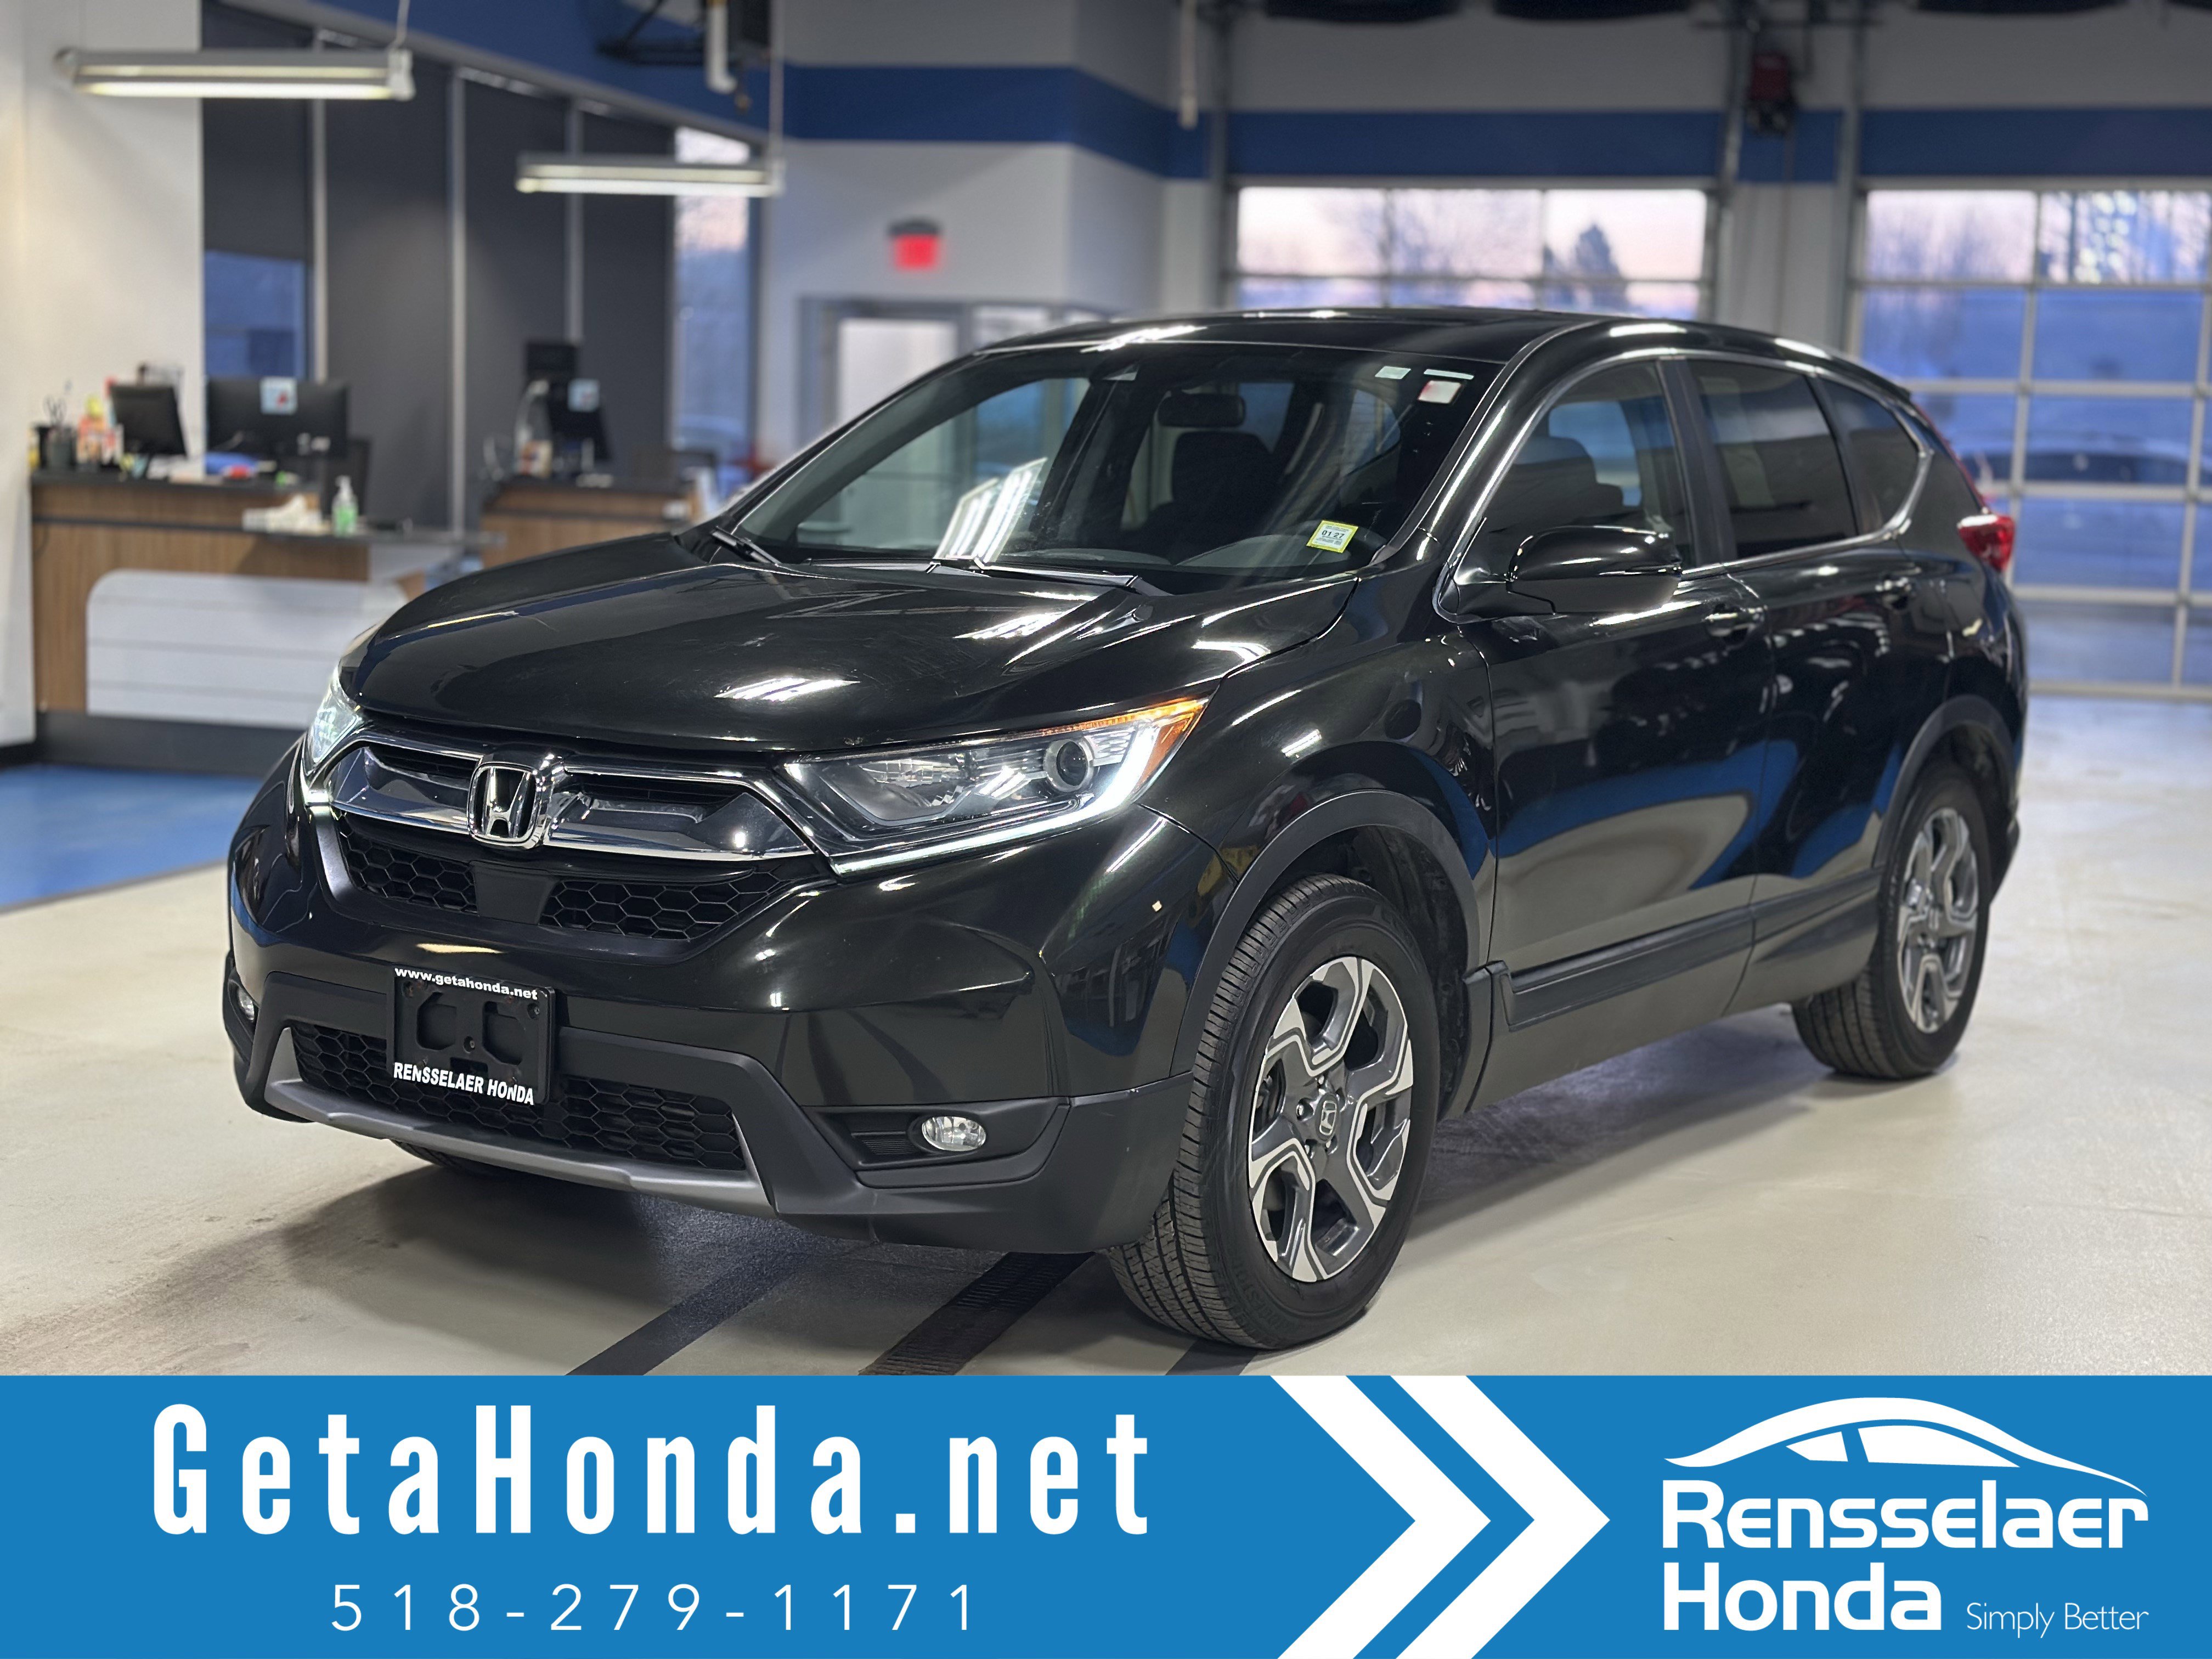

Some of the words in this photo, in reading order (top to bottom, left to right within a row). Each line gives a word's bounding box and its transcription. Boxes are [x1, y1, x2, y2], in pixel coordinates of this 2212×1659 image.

[394, 967, 538, 1000] www.getahonda.net
[393, 1062, 484, 1094] RENSSELAER
[487, 1079, 534, 1105] HONDA
